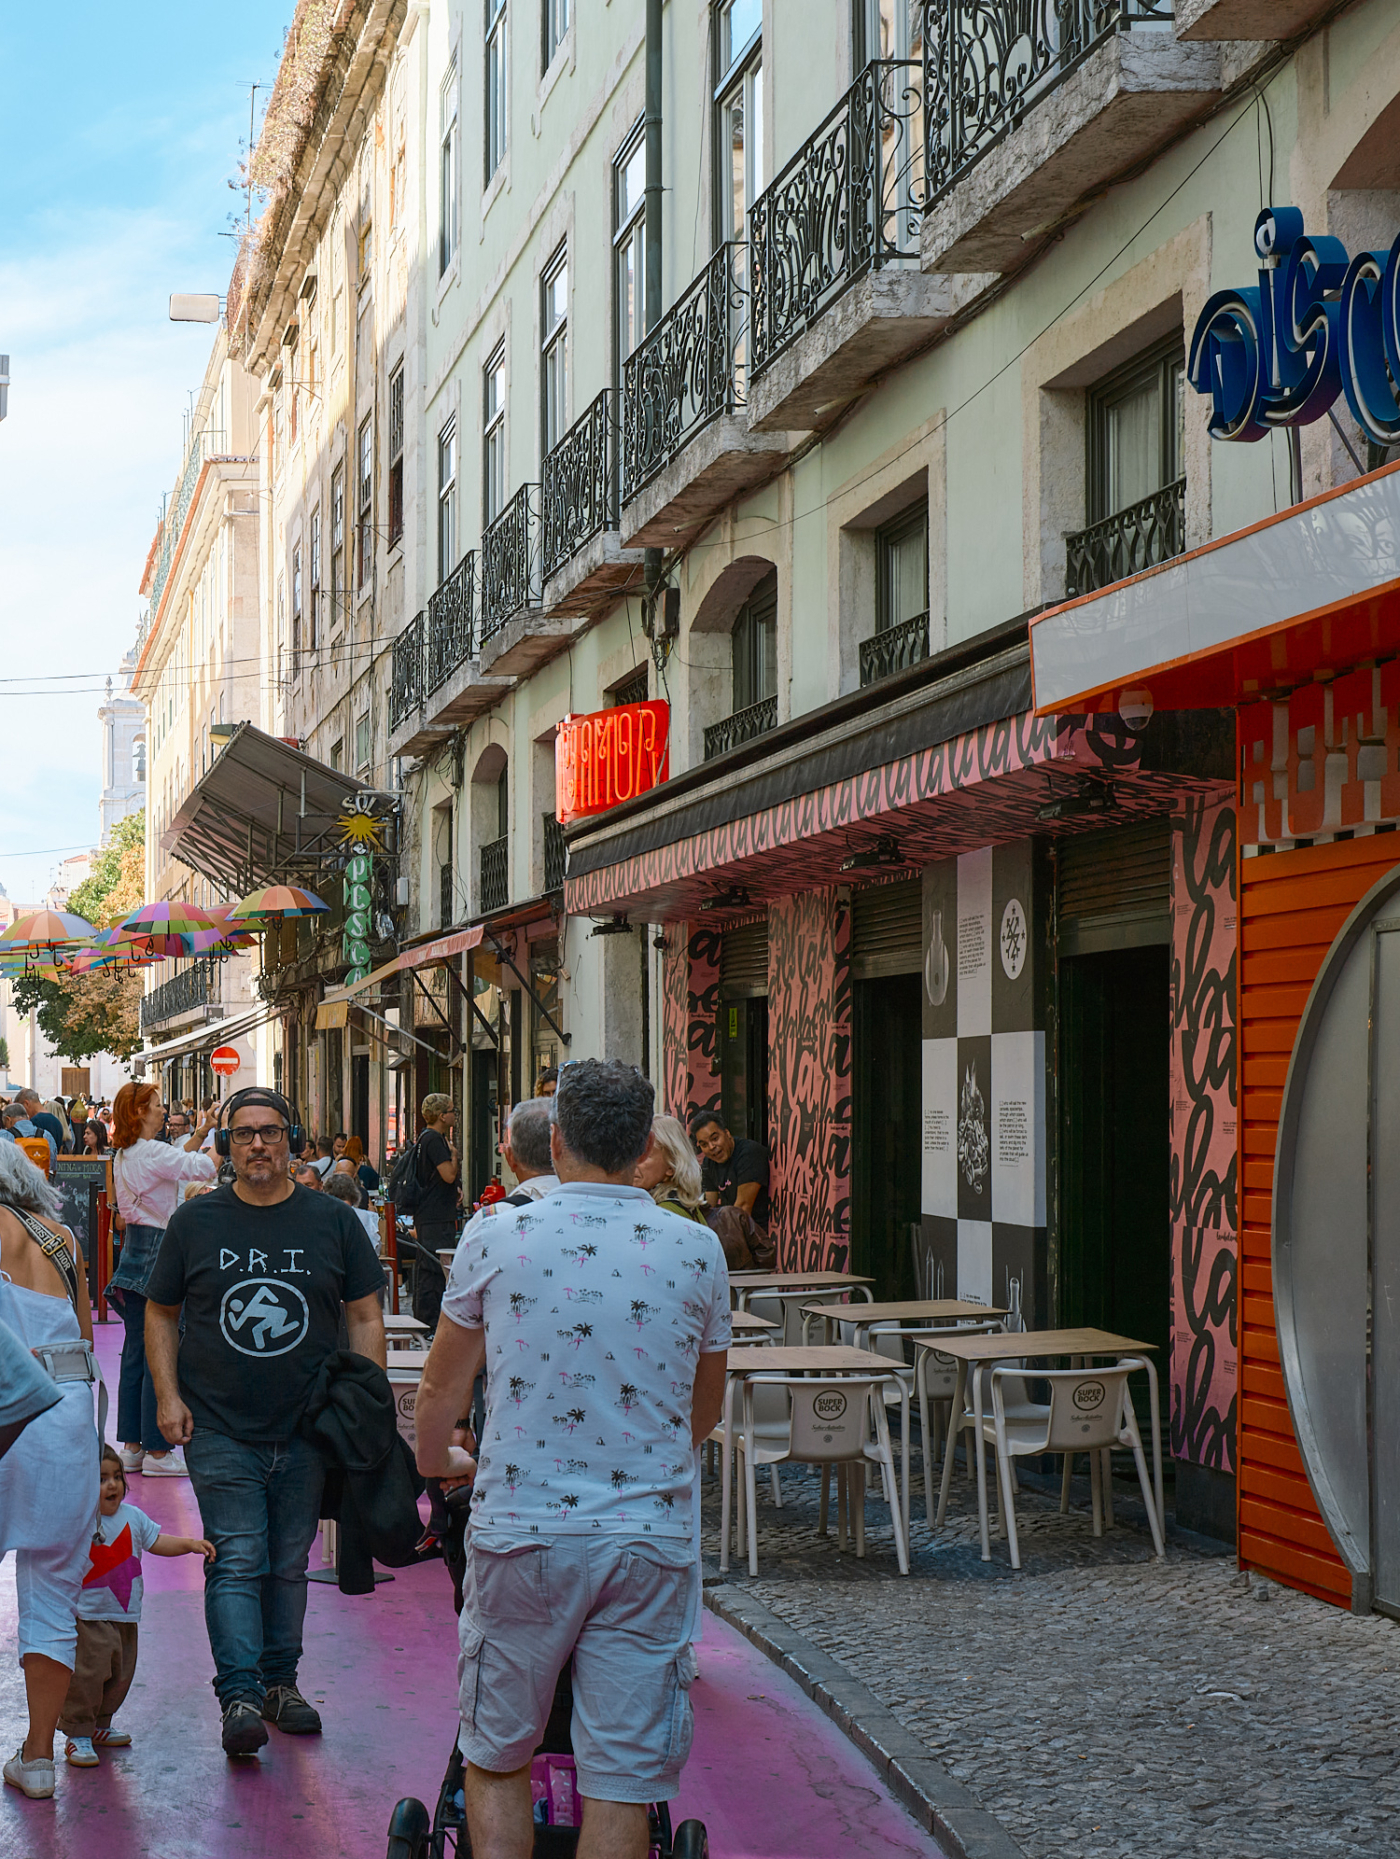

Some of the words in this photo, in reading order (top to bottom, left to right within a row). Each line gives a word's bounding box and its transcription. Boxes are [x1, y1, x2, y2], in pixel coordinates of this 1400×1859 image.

[342, 794, 377, 817] SOL
[1077, 1388, 1102, 1397] SUPER
[817, 1398, 843, 1406] SUPER
